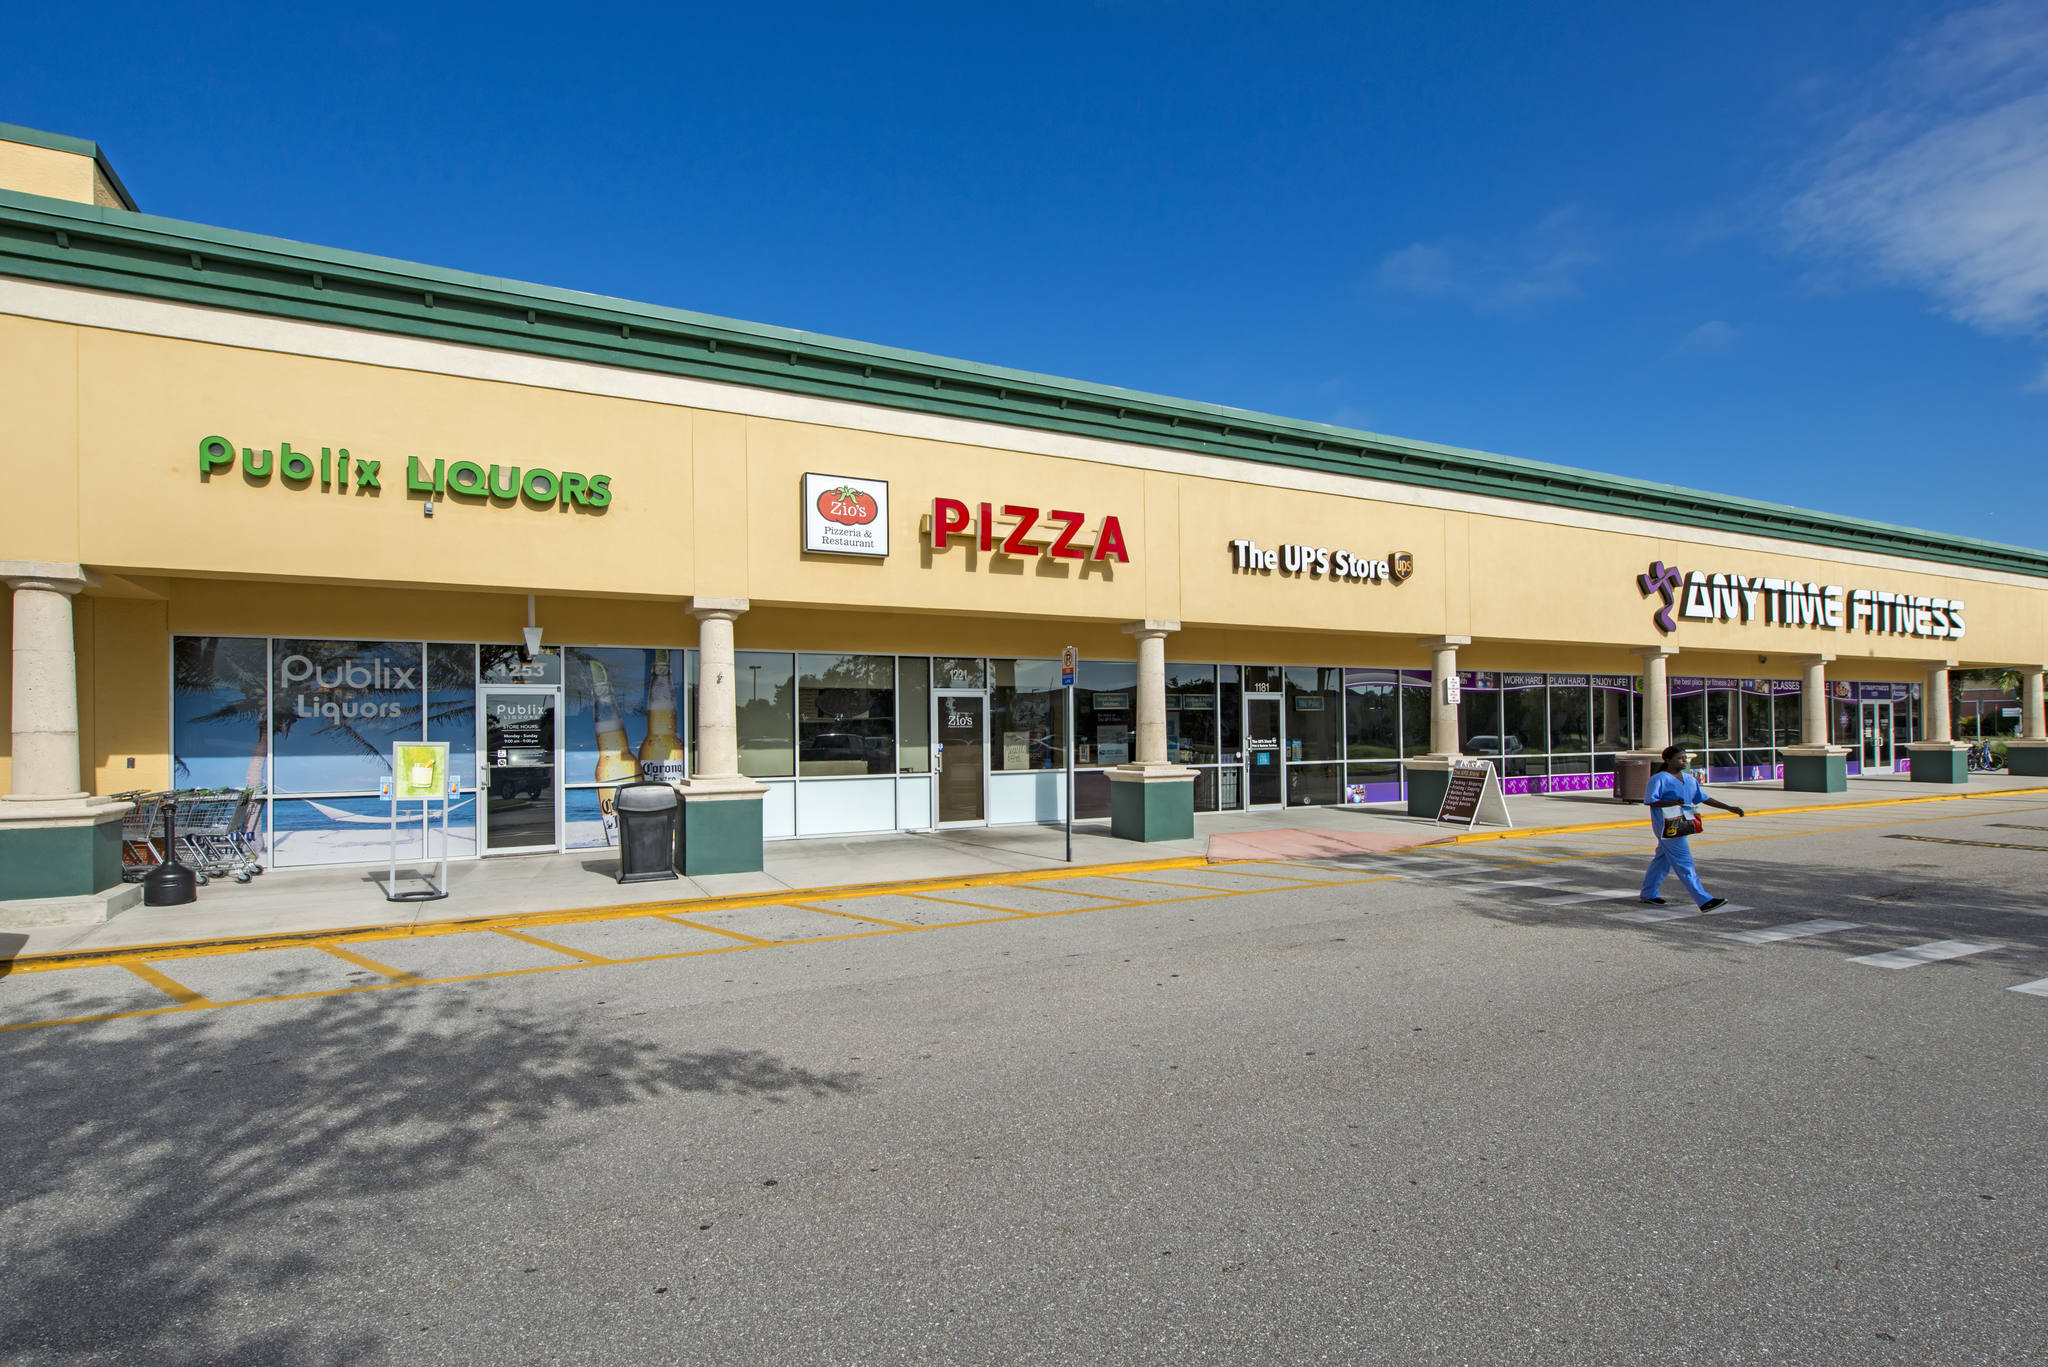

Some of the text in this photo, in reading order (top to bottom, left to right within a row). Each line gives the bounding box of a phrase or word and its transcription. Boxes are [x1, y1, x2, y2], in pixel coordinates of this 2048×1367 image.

[199, 435, 612, 507] Publix LIQUORS
[830, 501, 867, 518] Zio's
[824, 526, 873, 539] Pizzeria &
[931, 497, 1130, 563] PIZZA
[821, 536, 875, 548] Restaurant
[1231, 539, 1389, 580] The UPS Store
[1683, 570, 1966, 638] ANYTIME FITNESS
[281, 655, 416, 689] Publix
[497, 664, 544, 677] 1253
[949, 669, 968, 680] 1221
[1504, 675, 1544, 685] WORK HARD
[1550, 677, 1567, 685] PLAY
[1591, 678, 1612, 687] ENJOY
[1773, 682, 1799, 690] CLASSES
[1254, 682, 1270, 693] 1181
[298, 694, 401, 725] Liquors
[497, 704, 545, 715] Publix
[948, 714, 973, 726] Zio's
[642, 762, 683, 776] Corona
